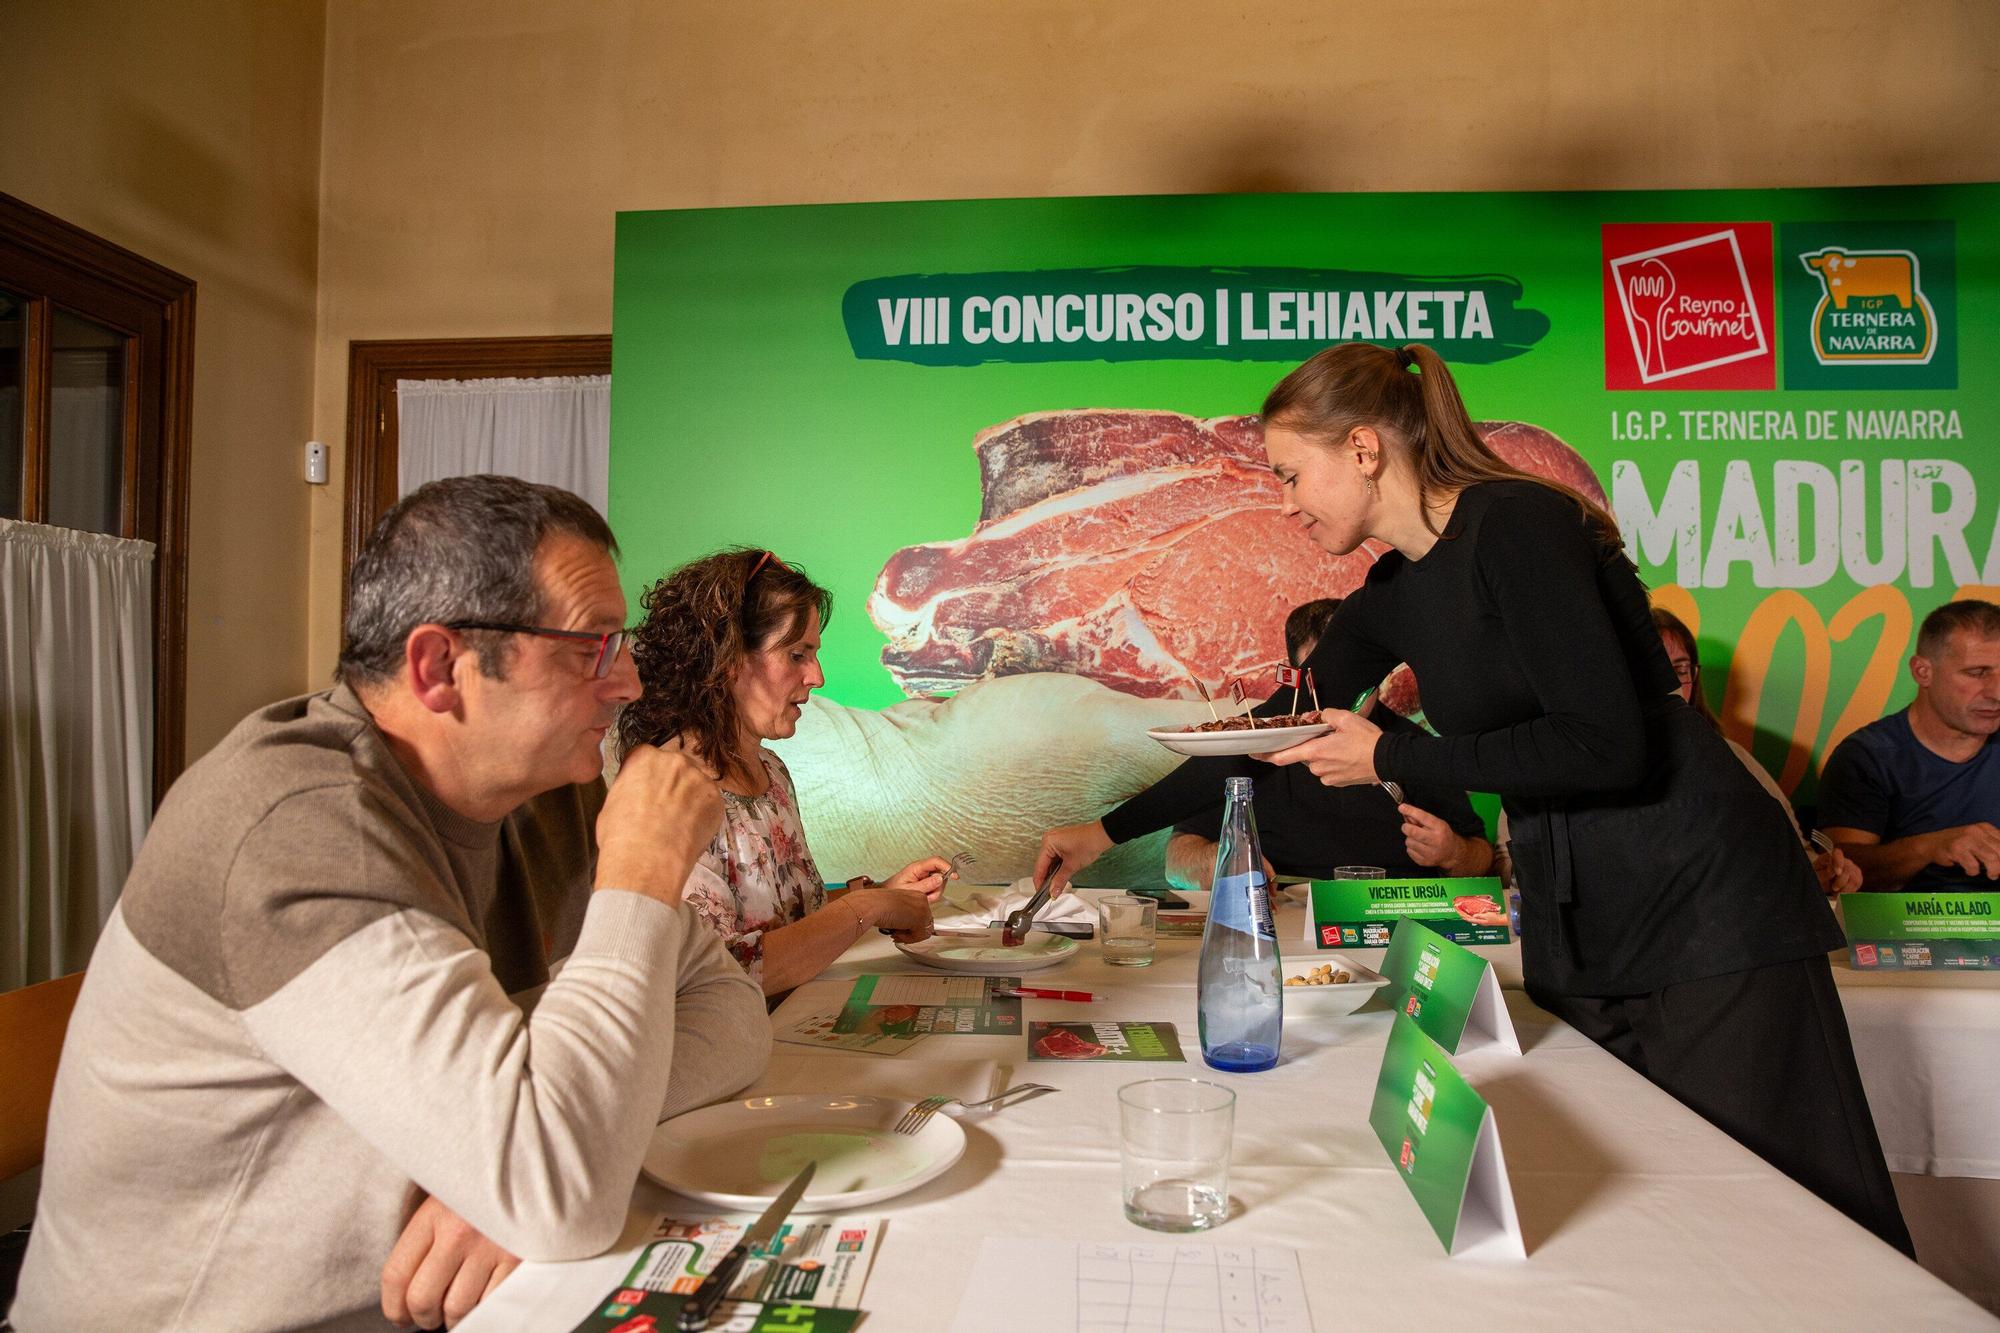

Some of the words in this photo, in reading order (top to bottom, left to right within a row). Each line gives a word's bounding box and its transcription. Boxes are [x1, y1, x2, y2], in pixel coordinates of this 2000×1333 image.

[1680, 296, 1735, 317] Reyno
[1861, 300, 1884, 309] IGP
[878, 297, 950, 345] VIII
[962, 293, 1203, 343] CONCURSO
[1241, 290, 1494, 340] LEHIAKETA
[1662, 302, 1755, 341] Gourmet
[1829, 312, 1916, 327] TERNERA
[1829, 336, 1916, 350] NAVARRA
[1611, 411, 1672, 440] I.G.P.
[1680, 410, 1798, 440] TERNERA
[1805, 410, 1838, 440] DE
[1846, 410, 1963, 439] NAVARRA
[1612, 459, 2000, 589] MADUR
[1368, 886, 1410, 900] VICENTE
[1412, 883, 1447, 899] URSÚA
[1906, 898, 1944, 915] MARÍA
[1945, 901, 1992, 915] CALADO
